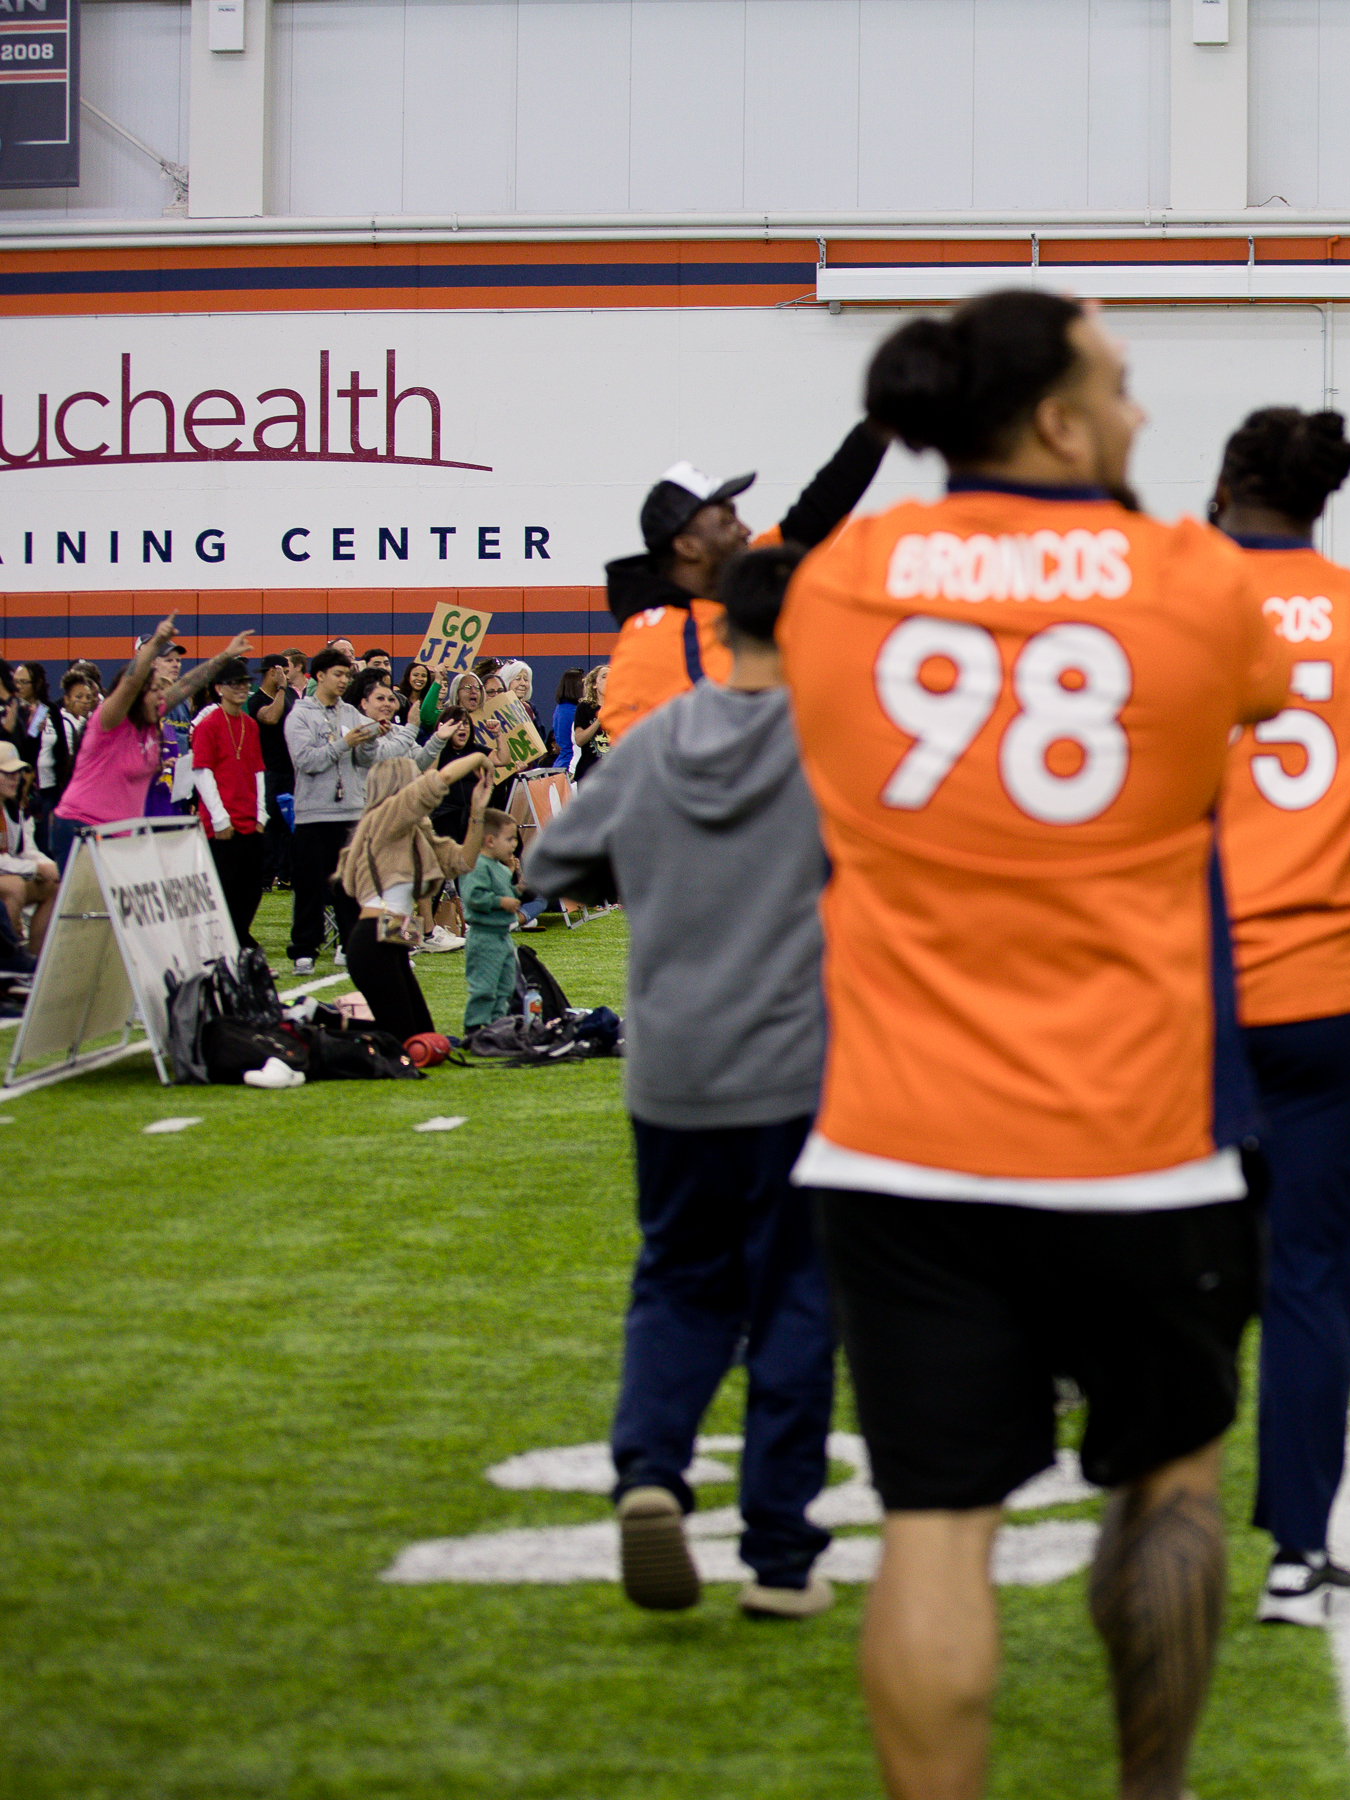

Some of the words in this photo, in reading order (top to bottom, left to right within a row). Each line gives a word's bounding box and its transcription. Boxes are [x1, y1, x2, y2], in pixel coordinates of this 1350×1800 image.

[1, 43, 54, 60] 2008
[0, 348, 441, 464] uchealth
[0, 528, 226, 563] INING
[281, 526, 551, 561] CENTER
[884, 527, 1133, 604] BRONCOS
[420, 638, 473, 671] JFK
[442, 611, 481, 643] GO
[873, 613, 1133, 827] 98
[1227, 660, 1340, 812] 5
